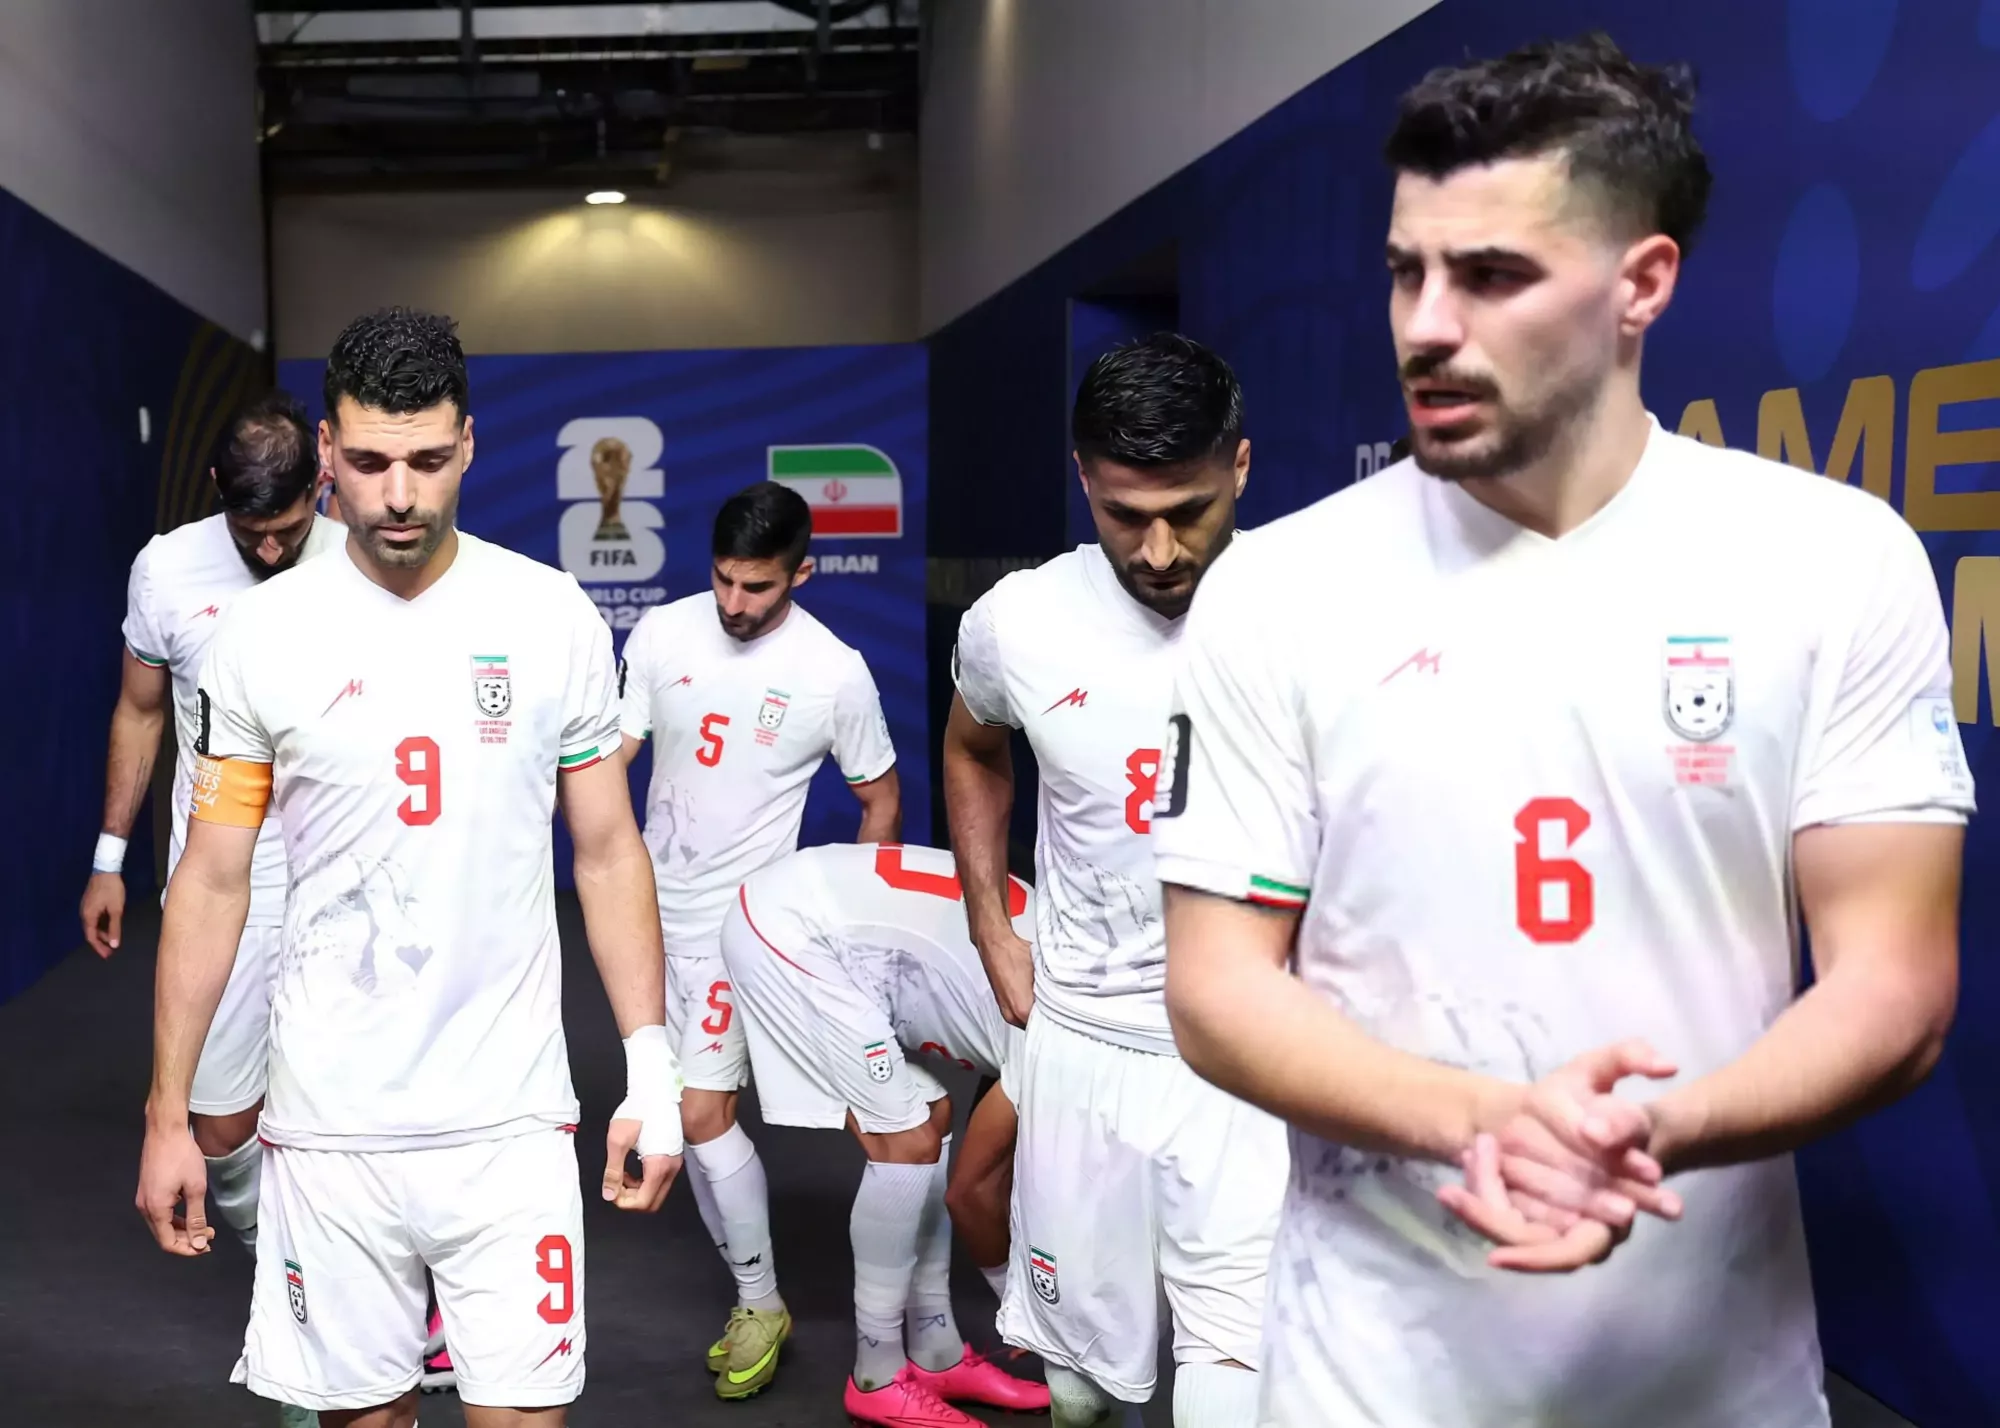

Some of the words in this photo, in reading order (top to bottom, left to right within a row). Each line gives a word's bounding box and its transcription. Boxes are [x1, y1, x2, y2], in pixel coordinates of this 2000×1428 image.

[590, 551, 637, 566] FIFA
[820, 555, 878, 573] IRAN
[629, 587, 667, 604] CUP
[696, 713, 731, 767] 5
[396, 736, 442, 827] 9
[1125, 748, 1161, 834] 8
[1514, 797, 1595, 944] 6
[701, 980, 733, 1035] 5
[535, 1234, 574, 1325] 9
